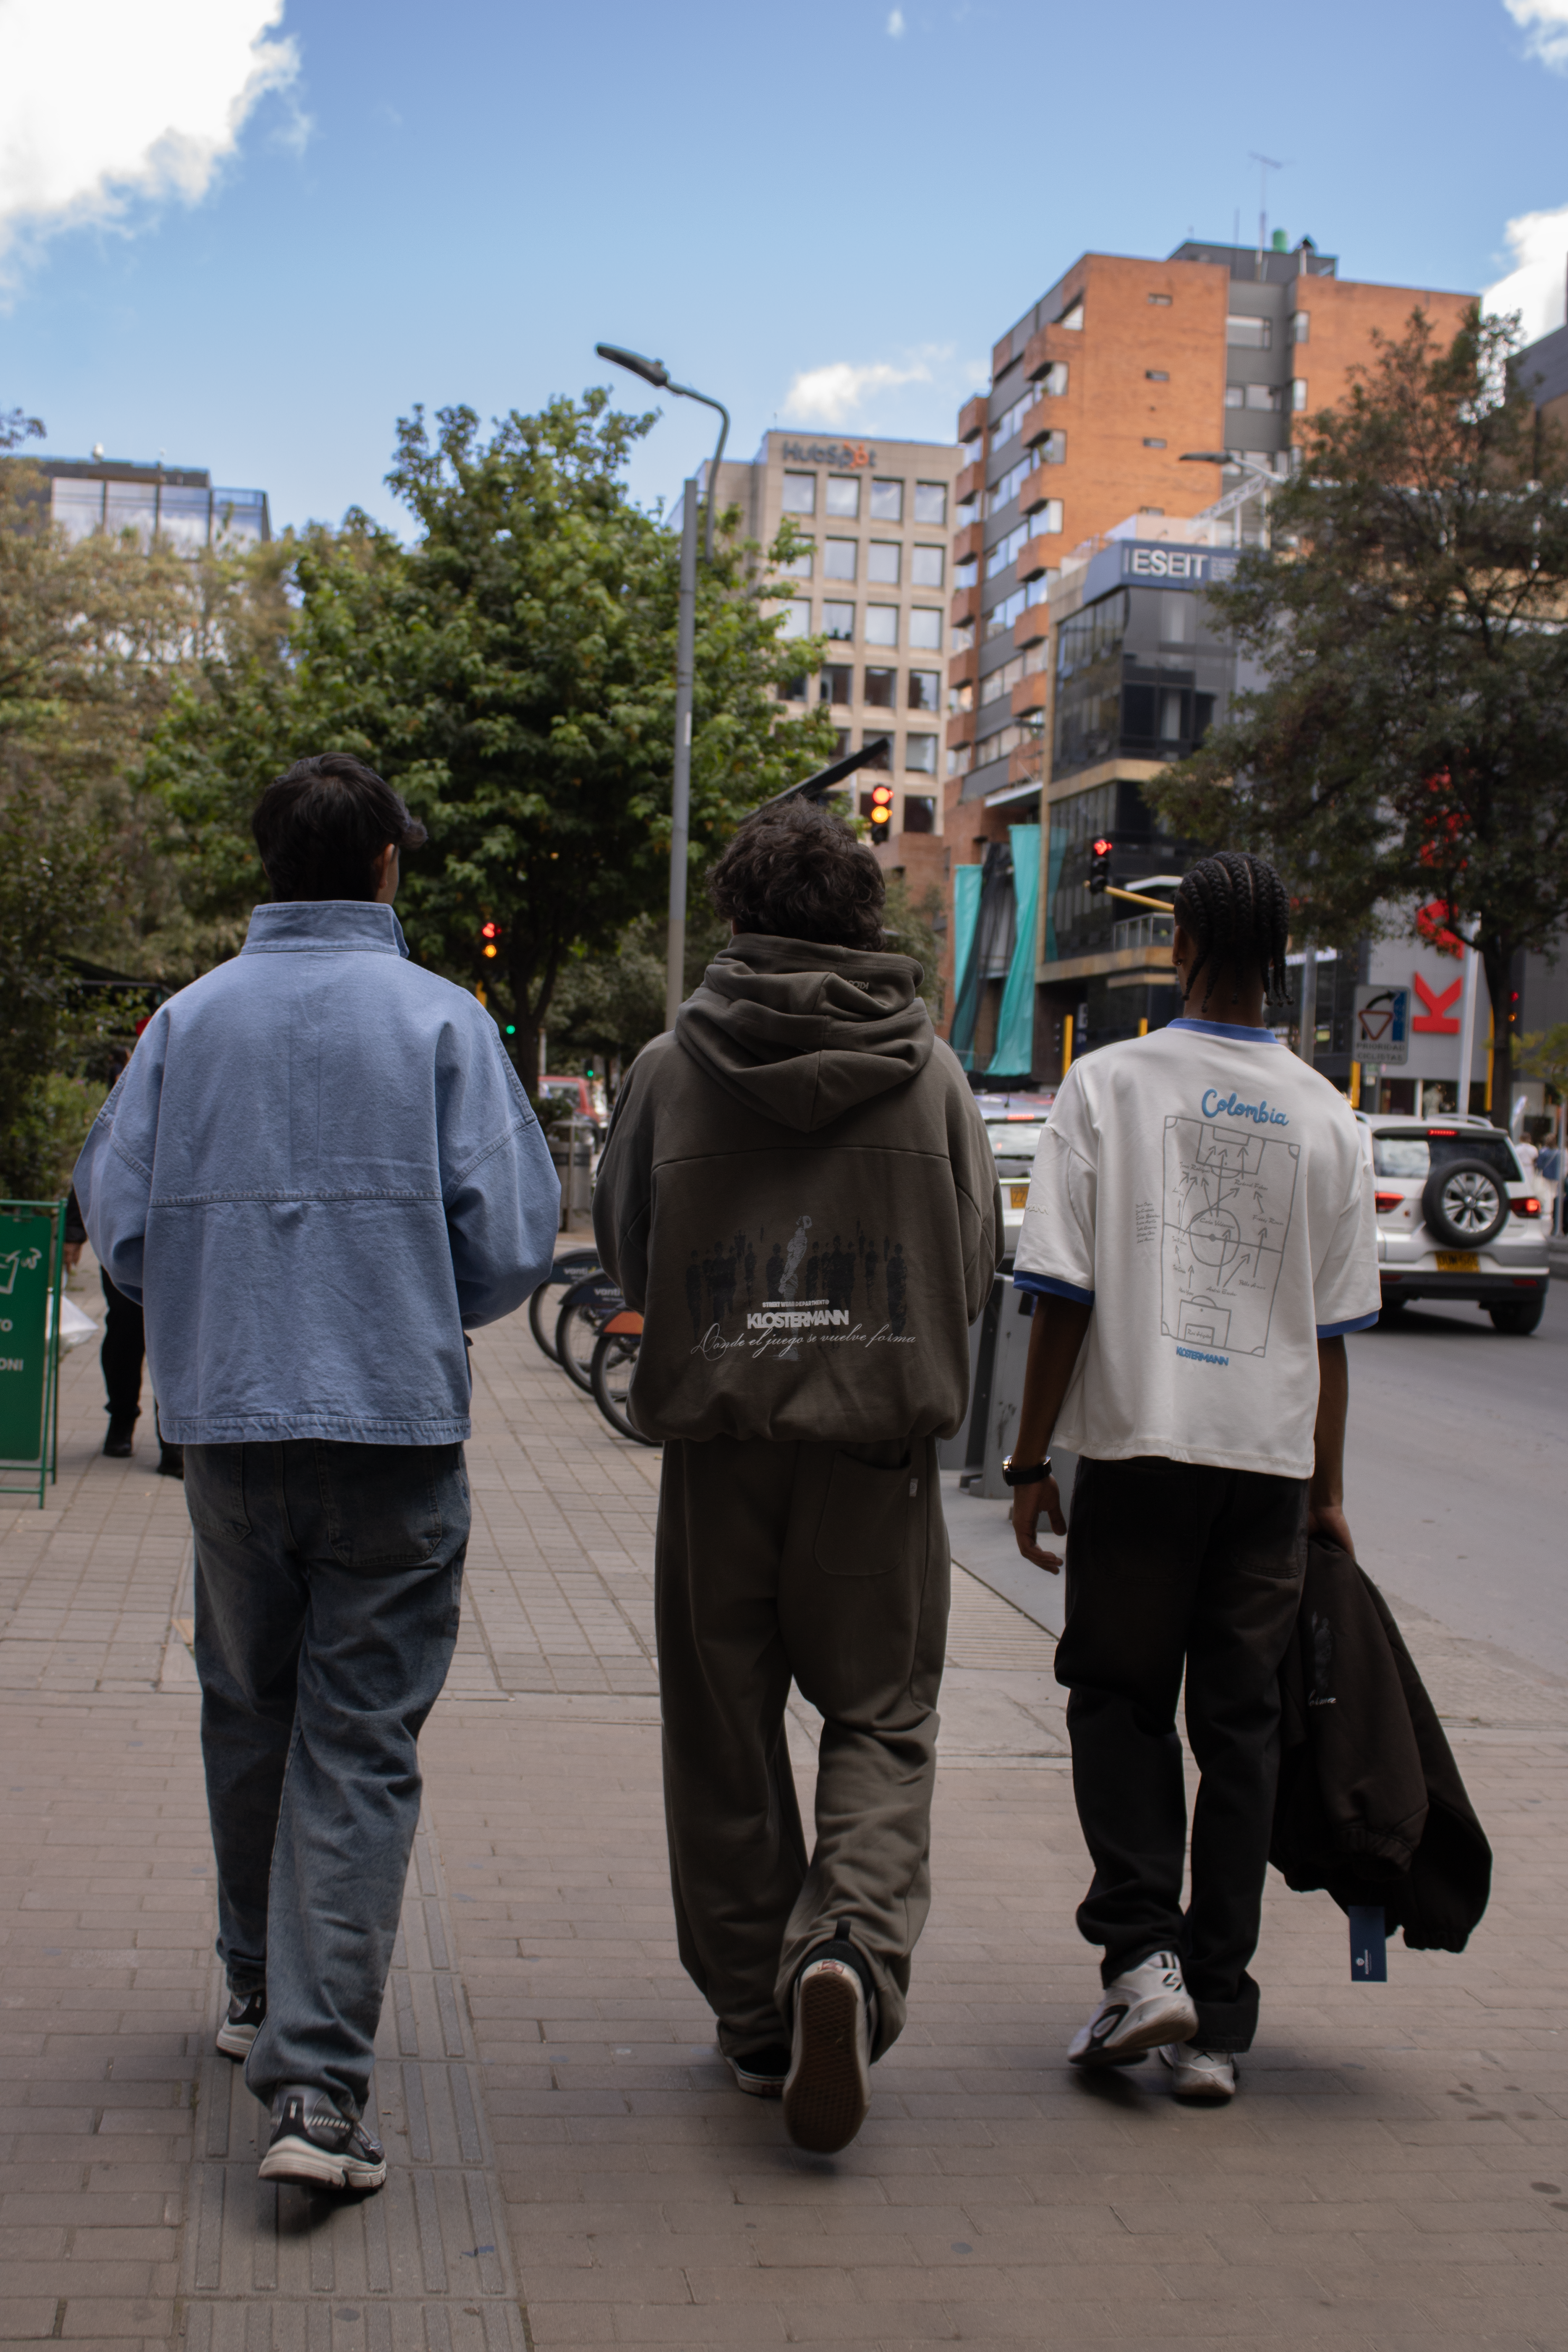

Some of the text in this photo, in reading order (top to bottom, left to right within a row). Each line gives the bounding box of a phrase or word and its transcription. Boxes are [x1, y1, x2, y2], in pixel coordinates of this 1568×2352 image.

[783, 440, 877, 469] HubSpot
[1131, 548, 1208, 579] ESEIT
[1201, 1088, 1289, 1126] Colombia
[564, 1267, 588, 1275] vanti
[594, 1288, 621, 1296] vanti
[0, 1319, 13, 1332] O
[747, 1310, 849, 1329] KLOSTERMANN
[690, 1323, 744, 1361] Donde
[752, 1333, 803, 1358] juego
[807, 1333, 817, 1342] se
[821, 1324, 866, 1342] vuelve
[865, 1324, 916, 1348] forma
[1176, 1346, 1229, 1366] KLOSTERMANN
